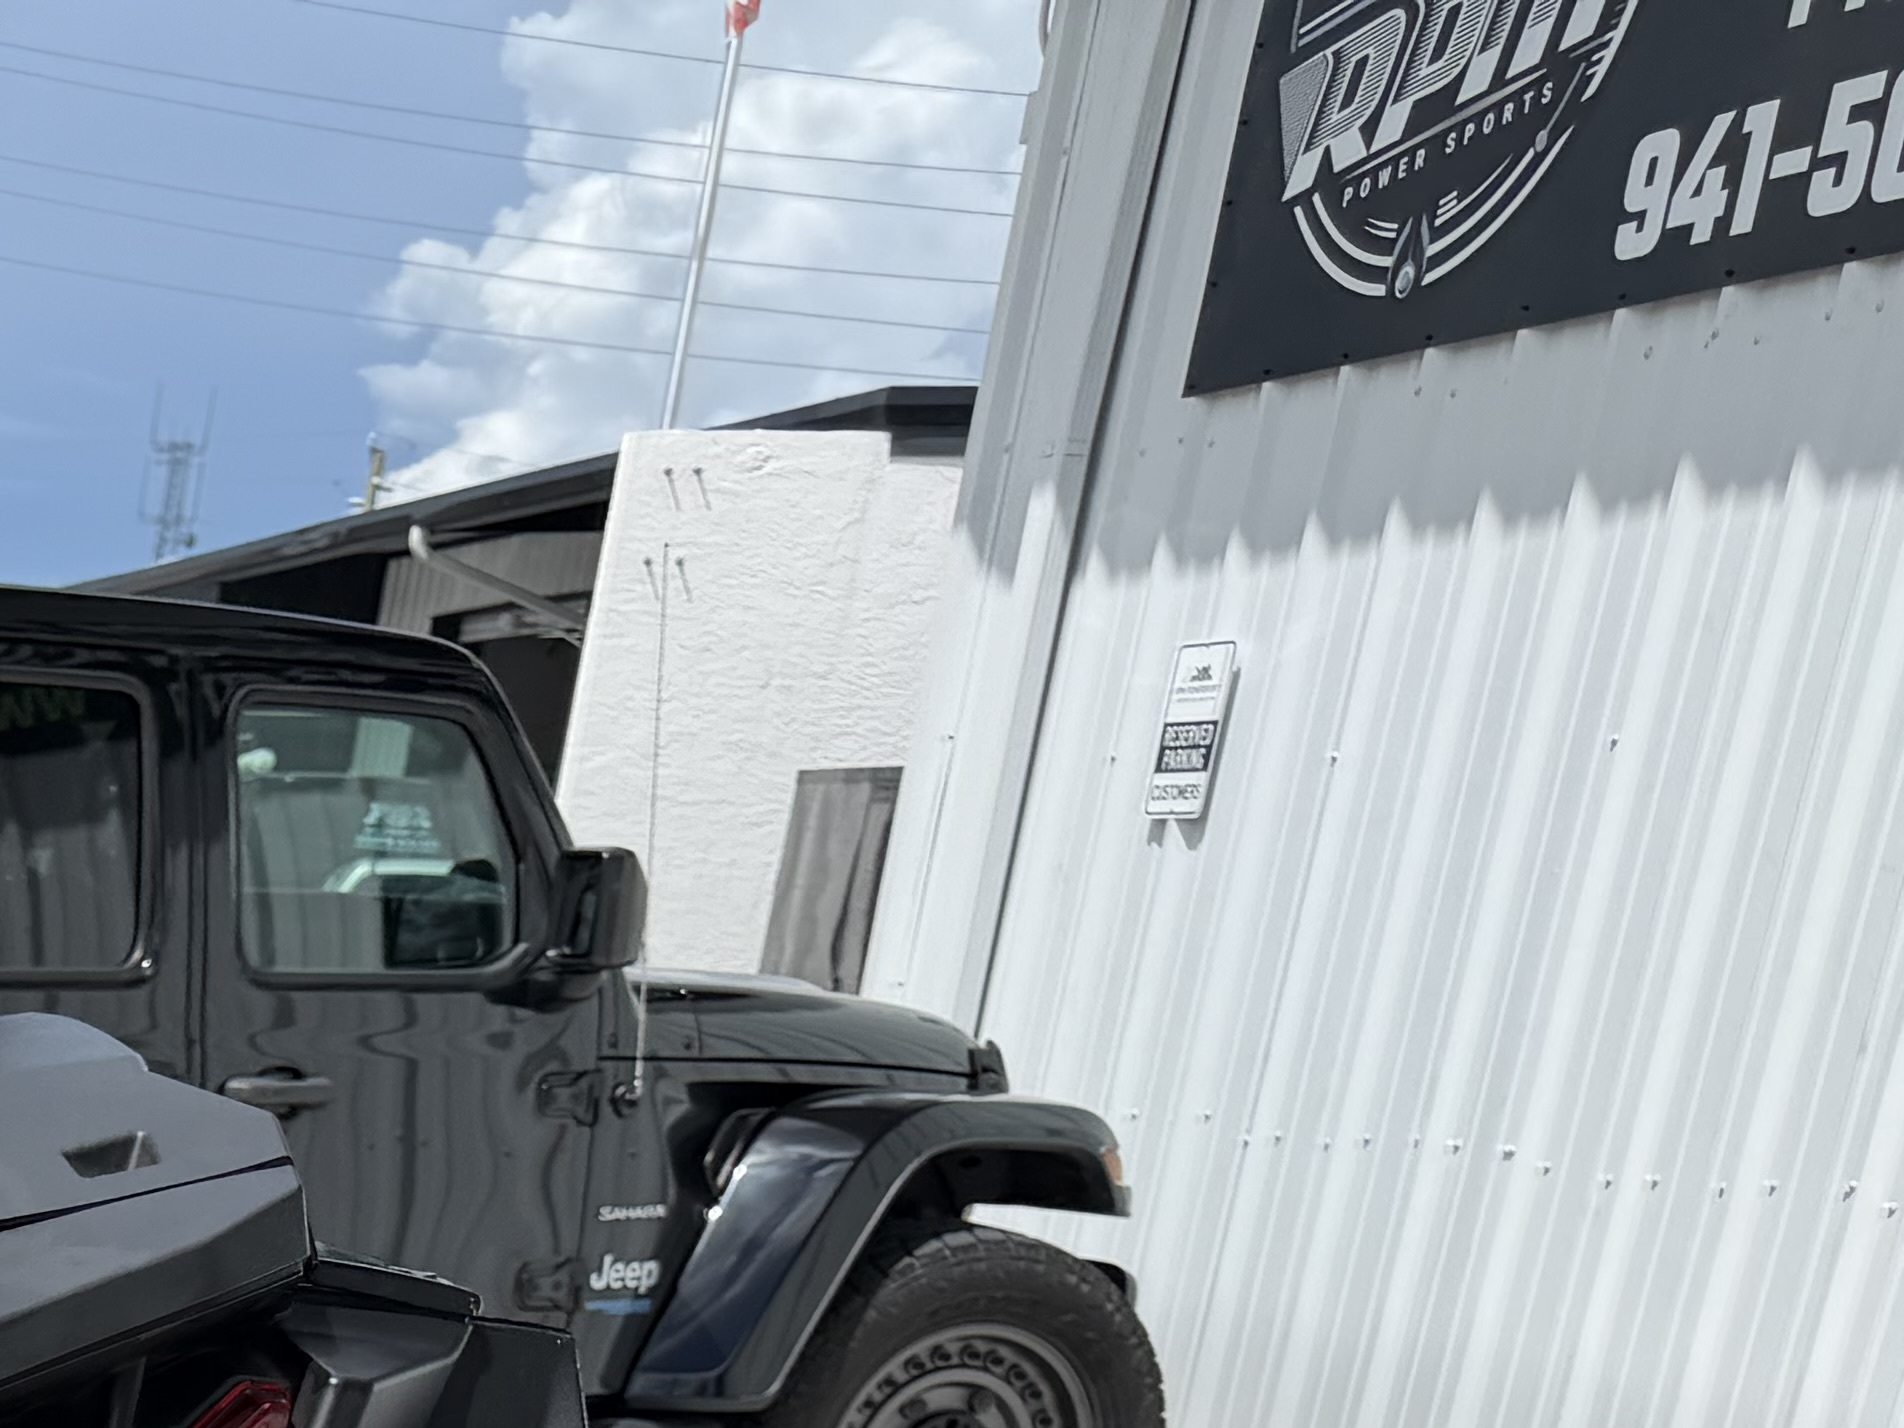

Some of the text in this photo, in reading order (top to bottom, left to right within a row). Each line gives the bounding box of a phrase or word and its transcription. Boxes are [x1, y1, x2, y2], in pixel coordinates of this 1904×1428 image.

[1342, 81, 1554, 208] POWER SPORTS
[589, 1253, 660, 1295] Jeep
